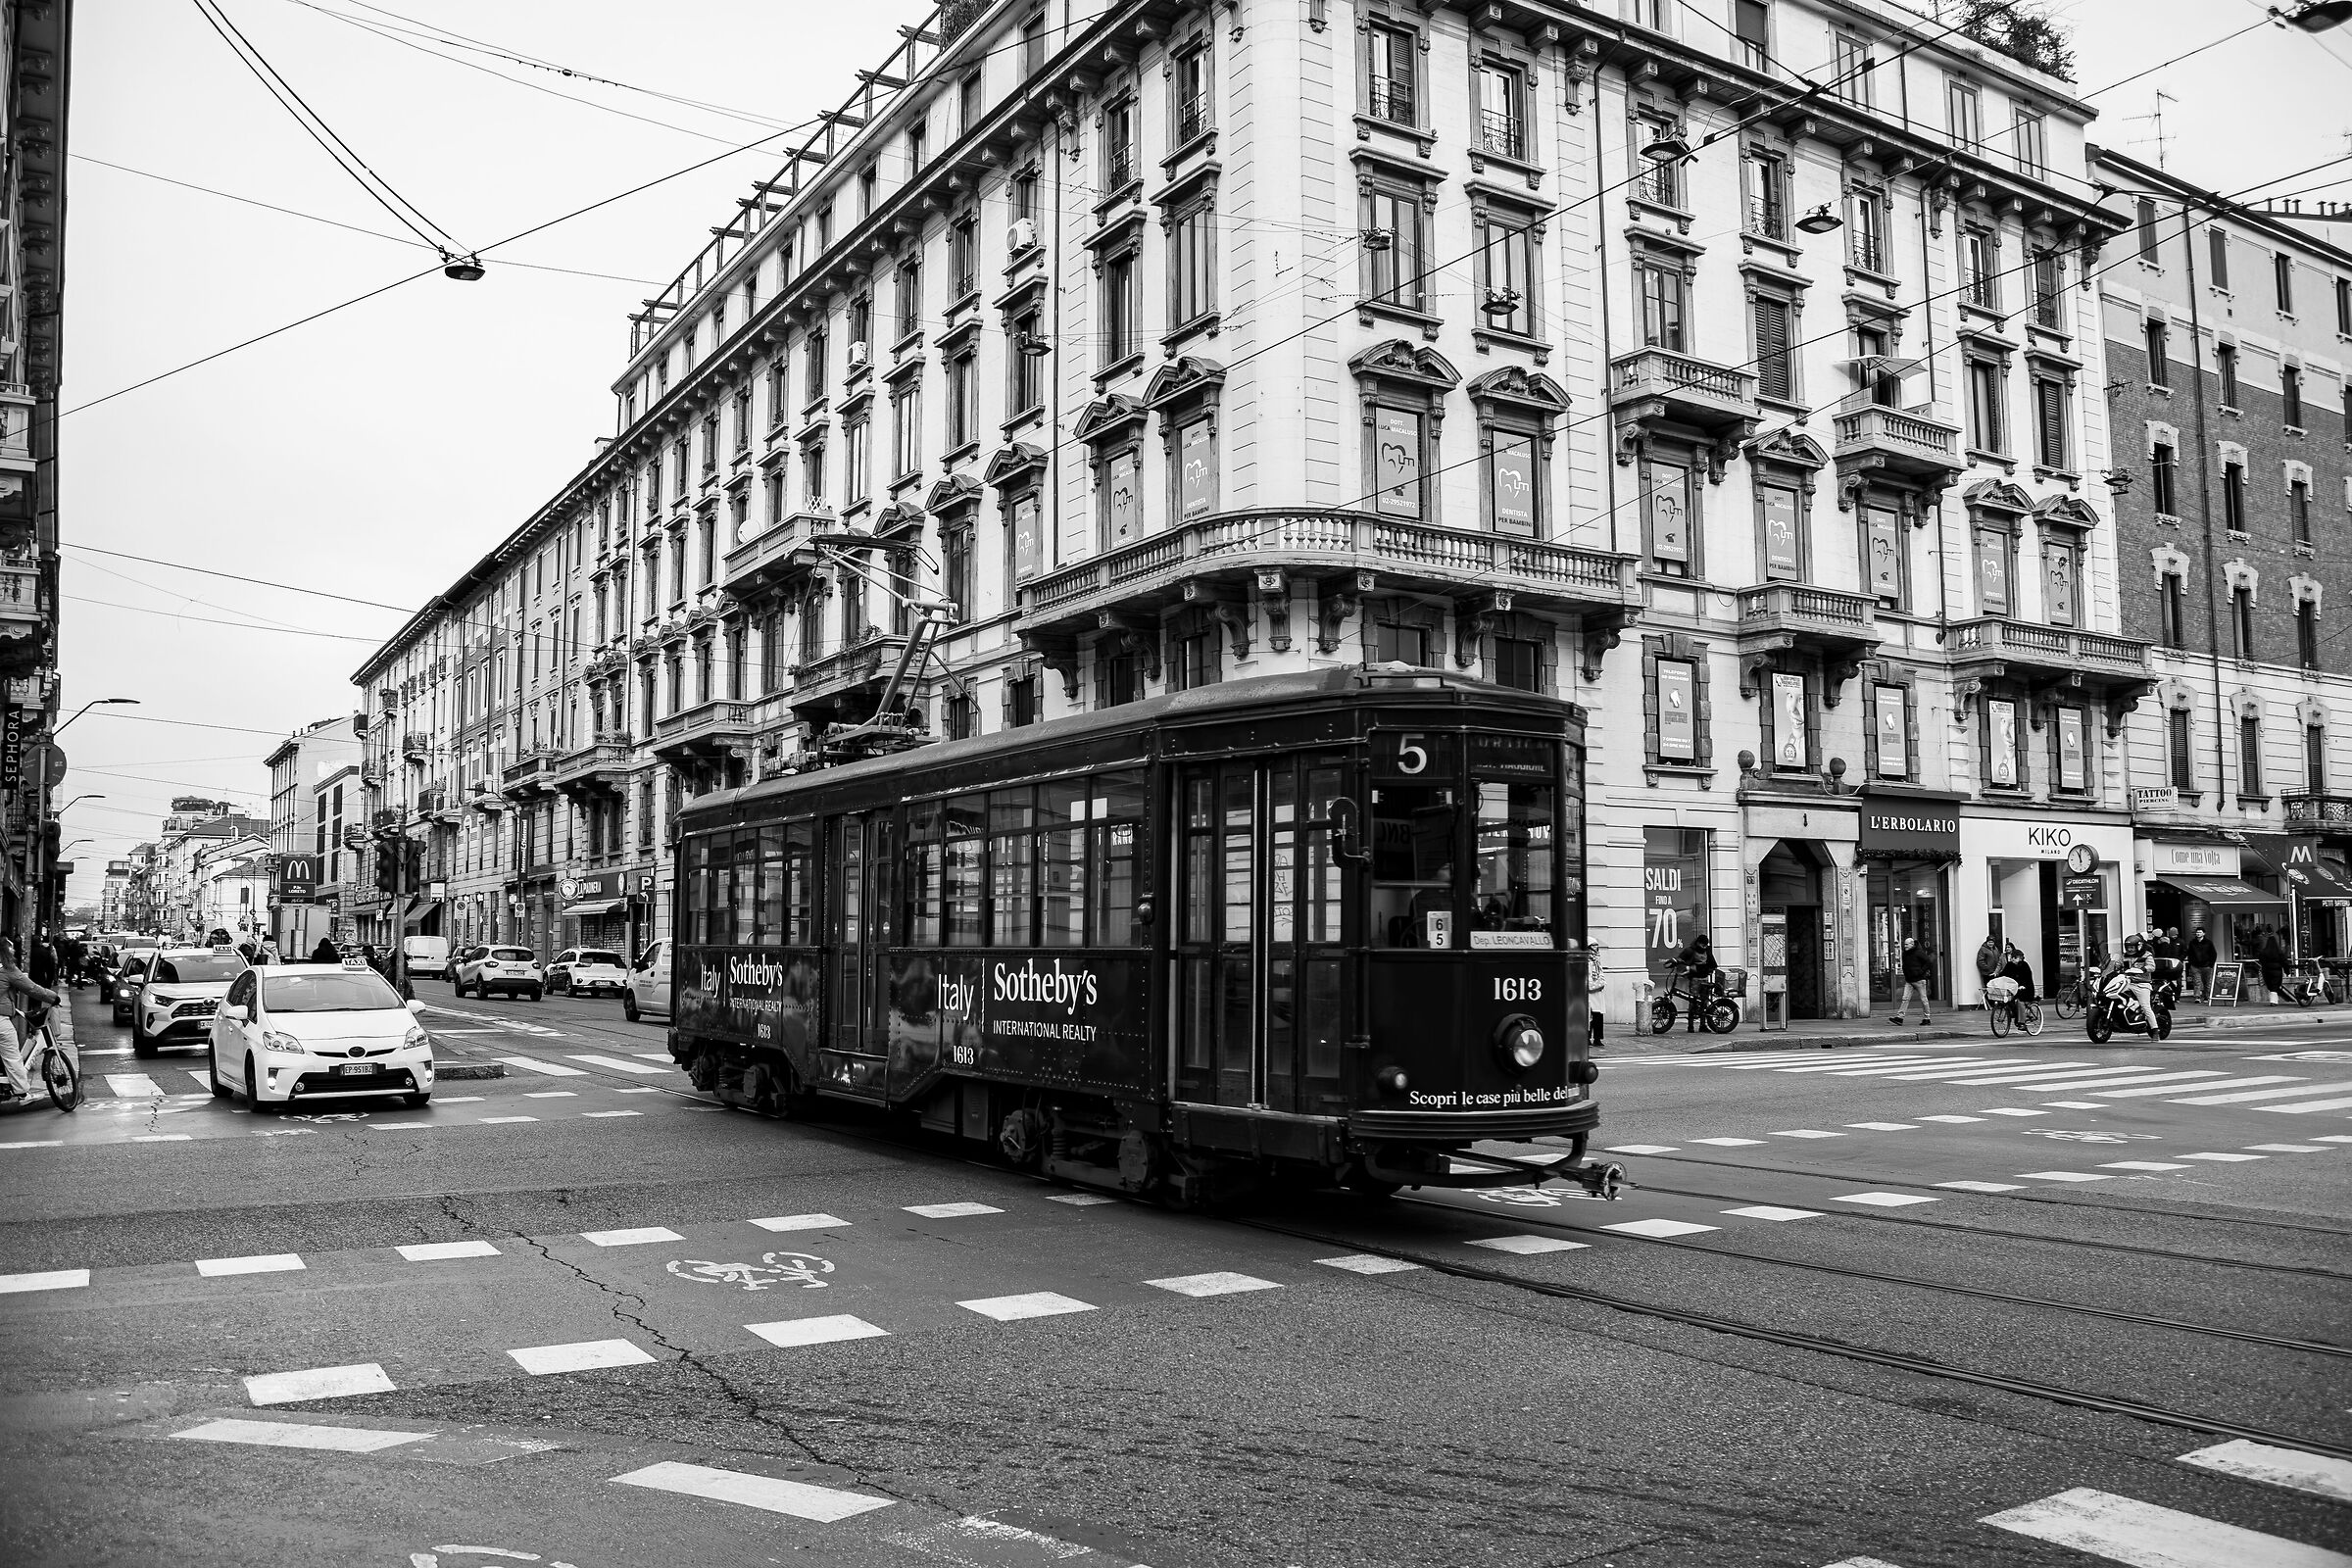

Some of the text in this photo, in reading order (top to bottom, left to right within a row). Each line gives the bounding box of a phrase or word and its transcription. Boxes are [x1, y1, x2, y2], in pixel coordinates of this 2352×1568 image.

[1391, 426, 1418, 436] MACALUSO
[1507, 450, 1531, 460] MACALUSO
[1382, 497, 1416, 509] 02-29521972
[1501, 508, 1528, 517] DENTISTA
[1509, 518, 1532, 527] BAMBINI
[5, 710, 20, 782] SEPHORA
[1397, 733, 1428, 774] 5
[2137, 788, 2172, 799] TATTOO
[1870, 815, 1956, 833] L'ERBOLARIO
[2029, 827, 2072, 847] KIKO
[2171, 848, 2221, 866] Come una Volta
[2289, 845, 2313, 863] M
[641, 876, 653, 891] P
[1645, 867, 1682, 892] SALDI
[1655, 895, 1672, 906] FINO A
[1436, 918, 1444, 931] 6
[1436, 933, 1444, 947] 5
[1473, 935, 1550, 948] Dep. LEONCAVALLO
[701, 963, 721, 999] Italy
[729, 953, 783, 994] Sotheby's
[994, 957, 1098, 1015] Sotheby's
[1494, 977, 1542, 1002] 1613
[729, 997, 783, 1012] INTERNATIONAL REALTY
[938, 973, 974, 1021] Italy
[758, 1023, 771, 1040] 1613
[993, 1019, 1097, 1042] INTERNATIONAL REALTY
[953, 1045, 974, 1065] 1613
[1409, 1090, 1457, 1109] Scopri
[1461, 1091, 1474, 1105] le
[1476, 1093, 1501, 1104] case
[1503, 1089, 1521, 1107] più
[1523, 1088, 1551, 1102] belle
